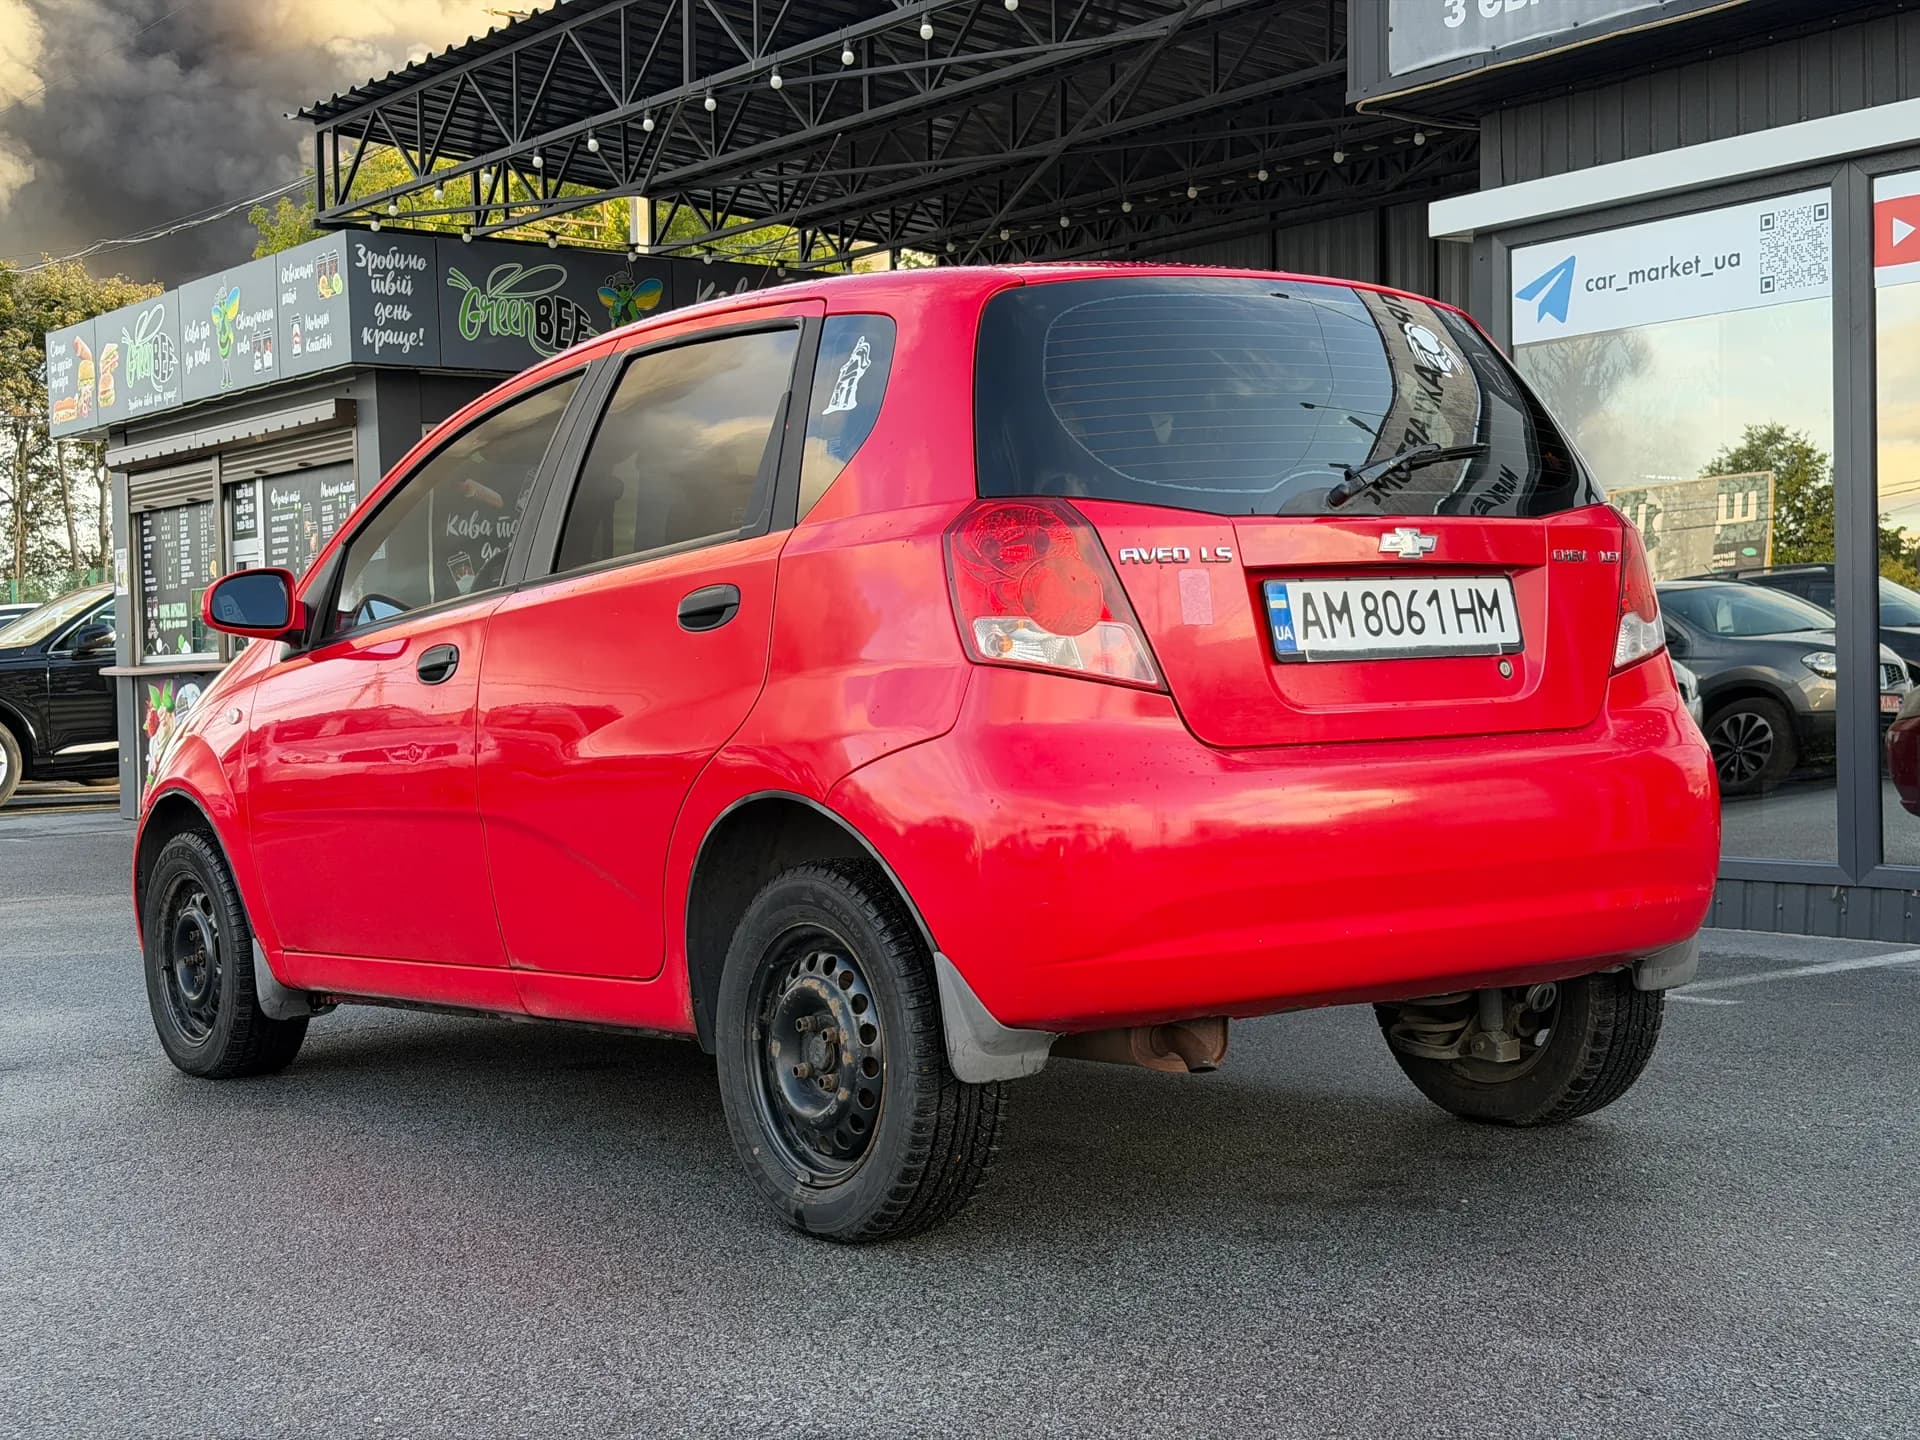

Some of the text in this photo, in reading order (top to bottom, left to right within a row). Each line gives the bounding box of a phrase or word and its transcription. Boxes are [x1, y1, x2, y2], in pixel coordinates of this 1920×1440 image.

[355, 243, 427, 277] Зробимо
[1585, 252, 1741, 292] car_market_ua
[371, 270, 414, 296] твій
[374, 302, 413, 326] день
[361, 326, 425, 355] краще!
[446, 510, 493, 540] Кава
[1119, 546, 1233, 564] AVEO LS
[1302, 587, 1506, 640] AM 8061 HM
[1275, 624, 1294, 641] UA
